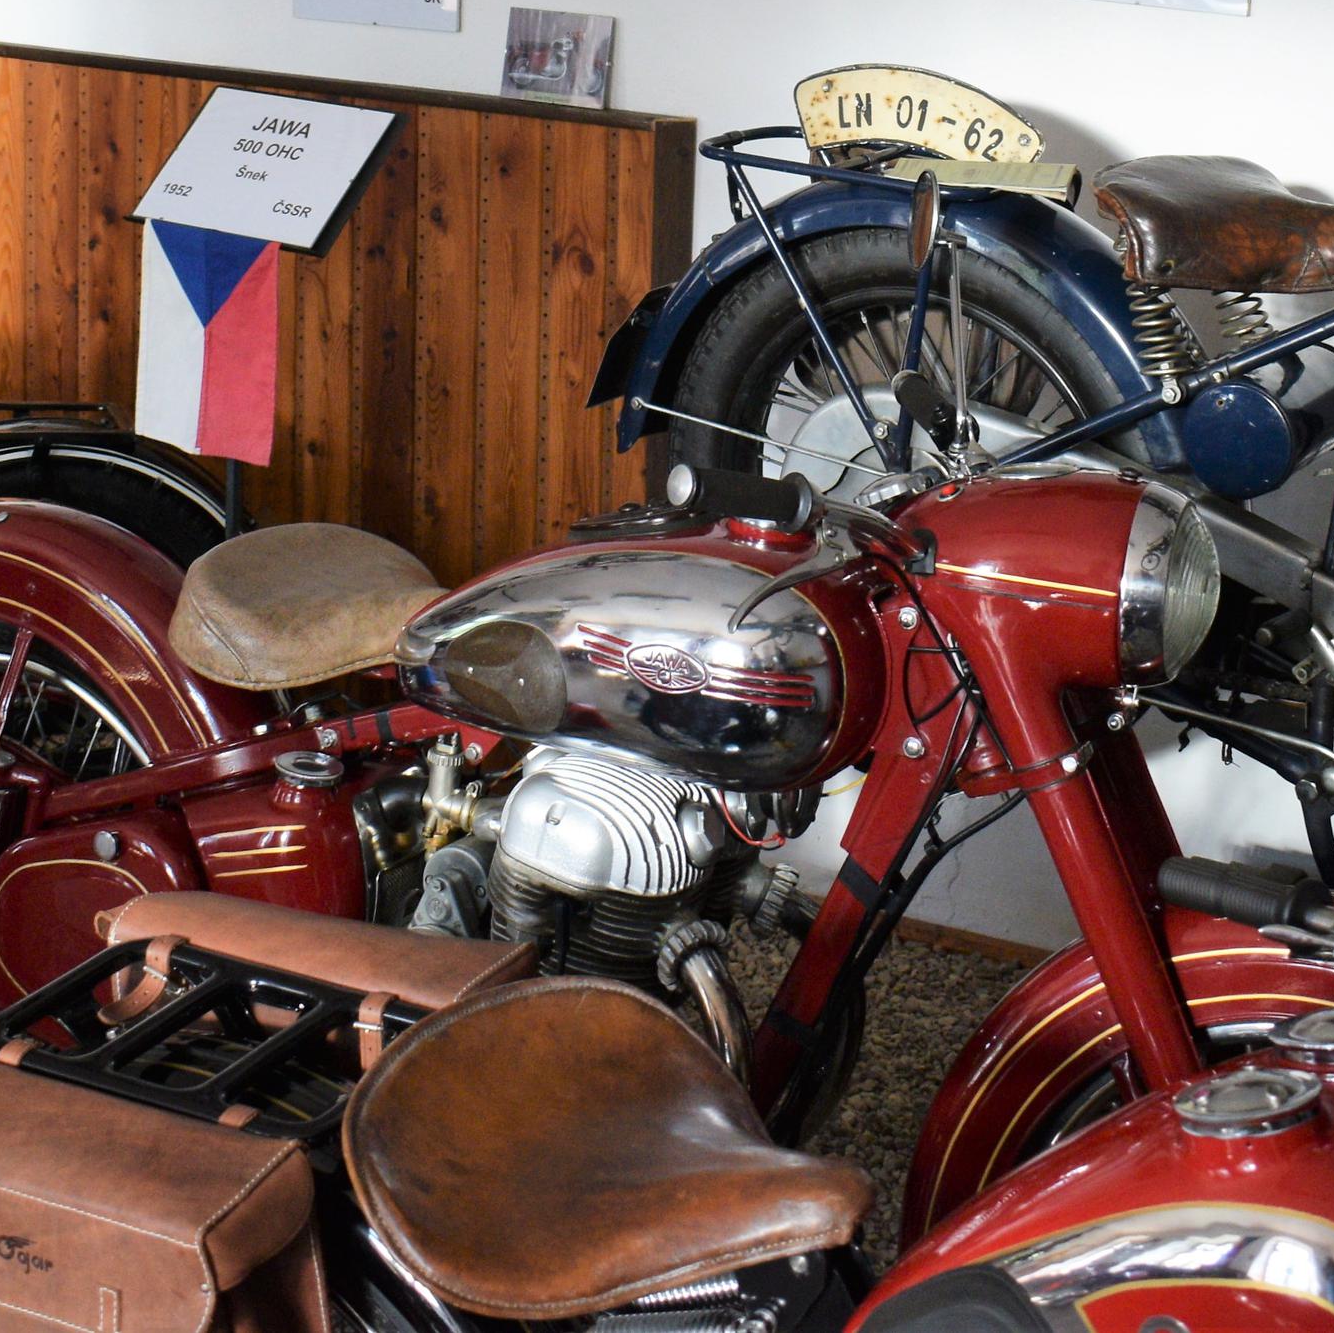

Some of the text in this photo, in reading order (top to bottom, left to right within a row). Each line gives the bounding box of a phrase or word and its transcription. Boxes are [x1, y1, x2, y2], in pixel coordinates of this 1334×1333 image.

[837, 92, 873, 129] LN
[251, 116, 312, 139] JAWA
[233, 138, 304, 161] 500 OHC
[235, 164, 269, 182] Šnek
[162, 182, 313, 219] 1952 ČSSR
[643, 650, 690, 675] JAWA
